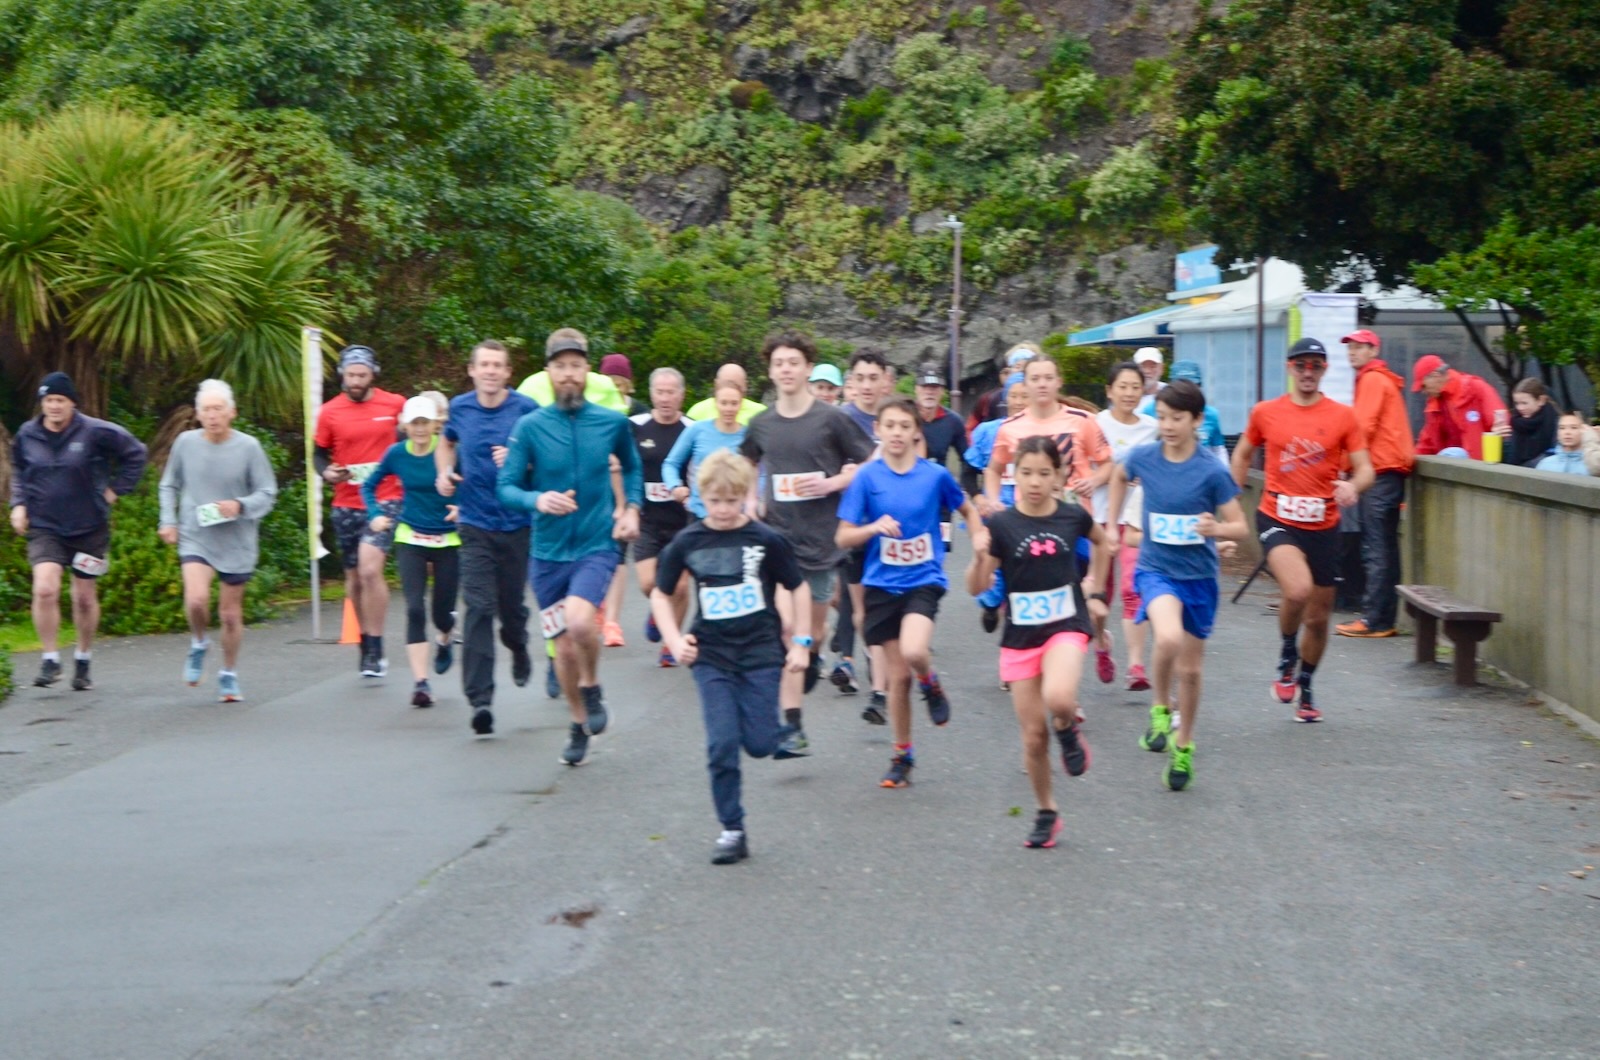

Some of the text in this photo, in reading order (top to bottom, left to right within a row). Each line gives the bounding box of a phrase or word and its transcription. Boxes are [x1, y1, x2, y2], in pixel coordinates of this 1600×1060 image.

[886, 538, 928, 562] 459
[705, 584, 758, 615] 236
[1014, 591, 1070, 620] 237
